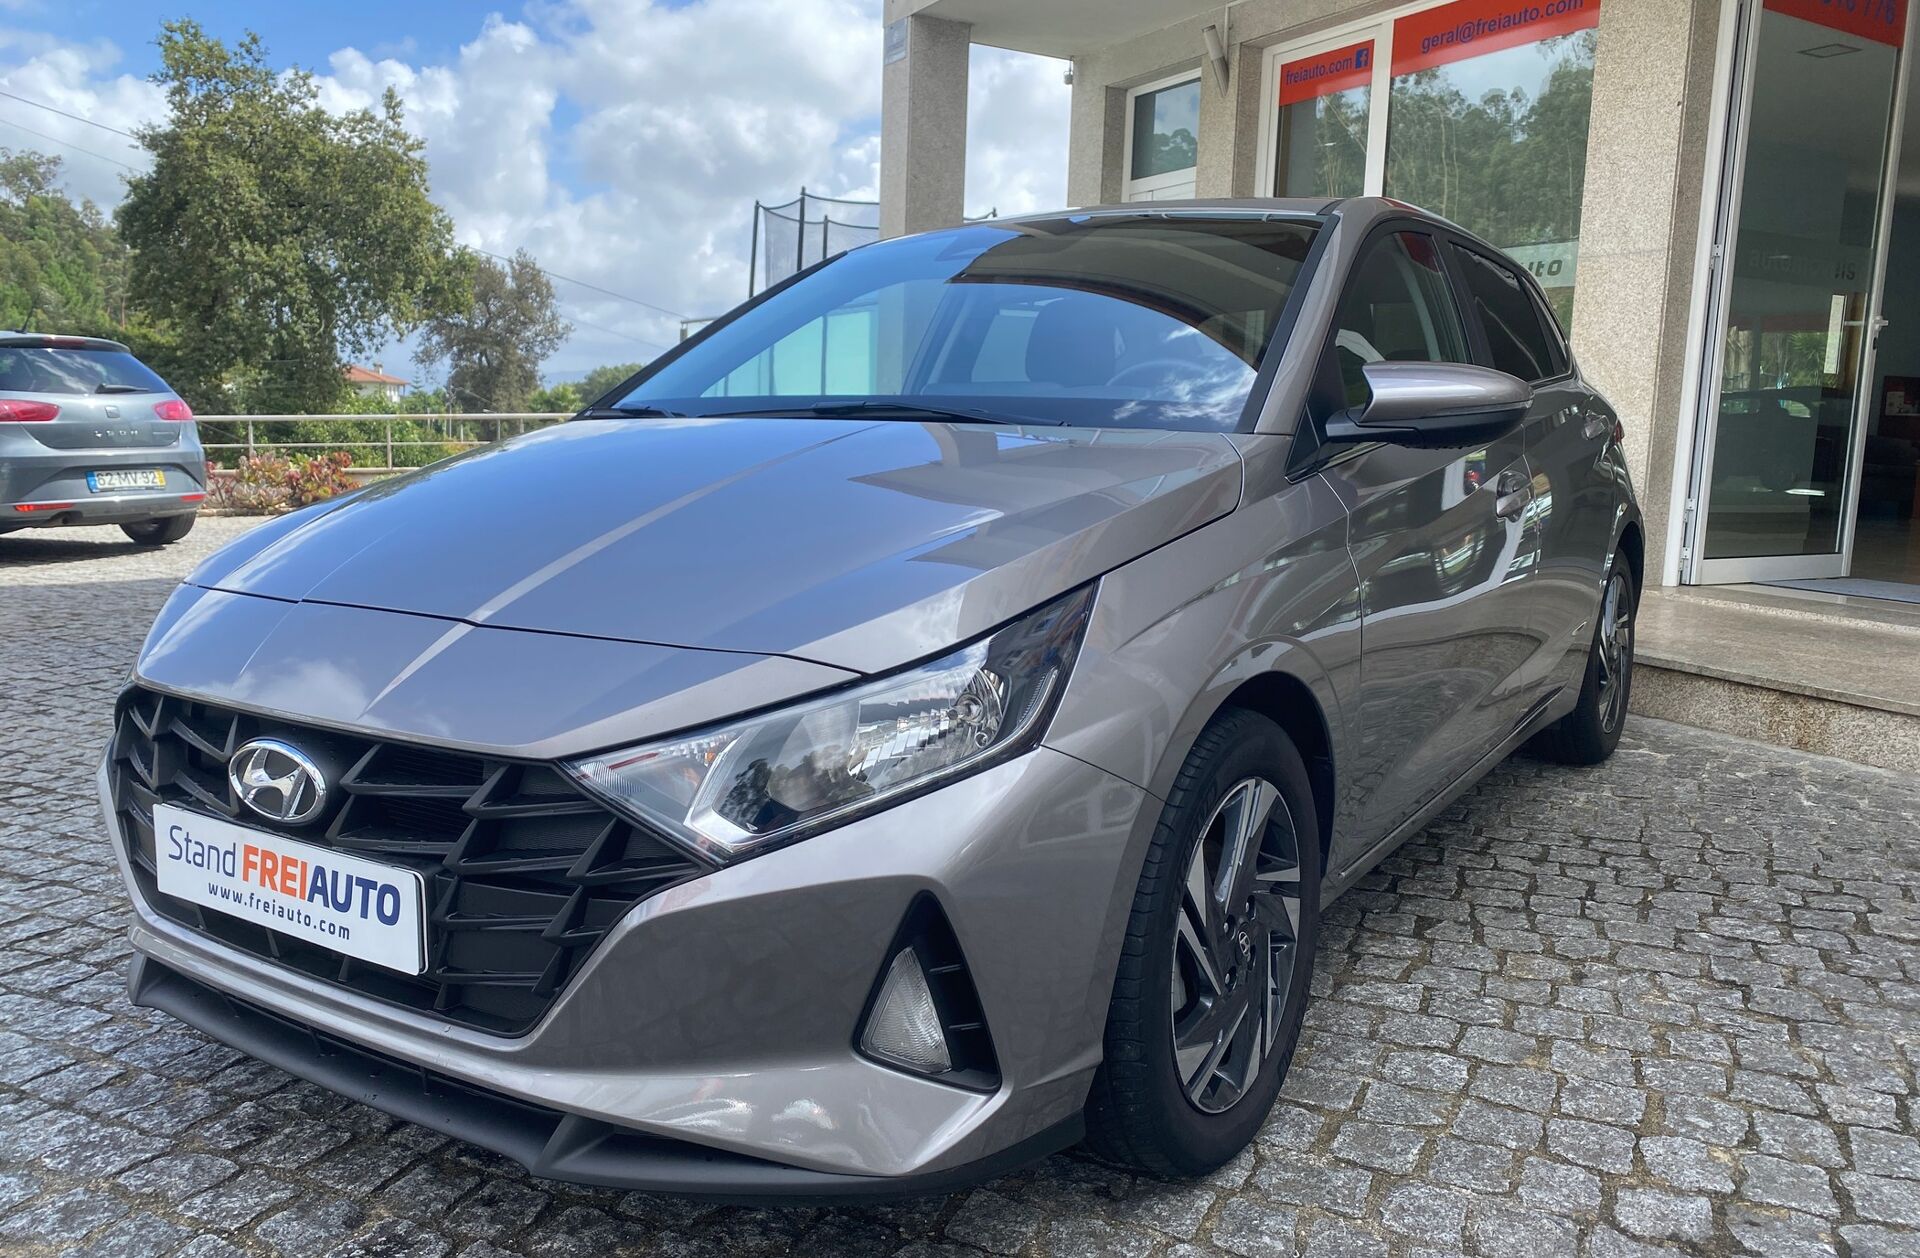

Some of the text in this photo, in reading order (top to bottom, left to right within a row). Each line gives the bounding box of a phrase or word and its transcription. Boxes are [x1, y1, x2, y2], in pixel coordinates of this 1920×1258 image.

[1421, 0, 1584, 54] geral@freiauto.com
[1286, 57, 1352, 85] freiauto.com
[168, 825, 401, 926] Stand FREIAUTO
[208, 882, 350, 941] www.freiauto.com
